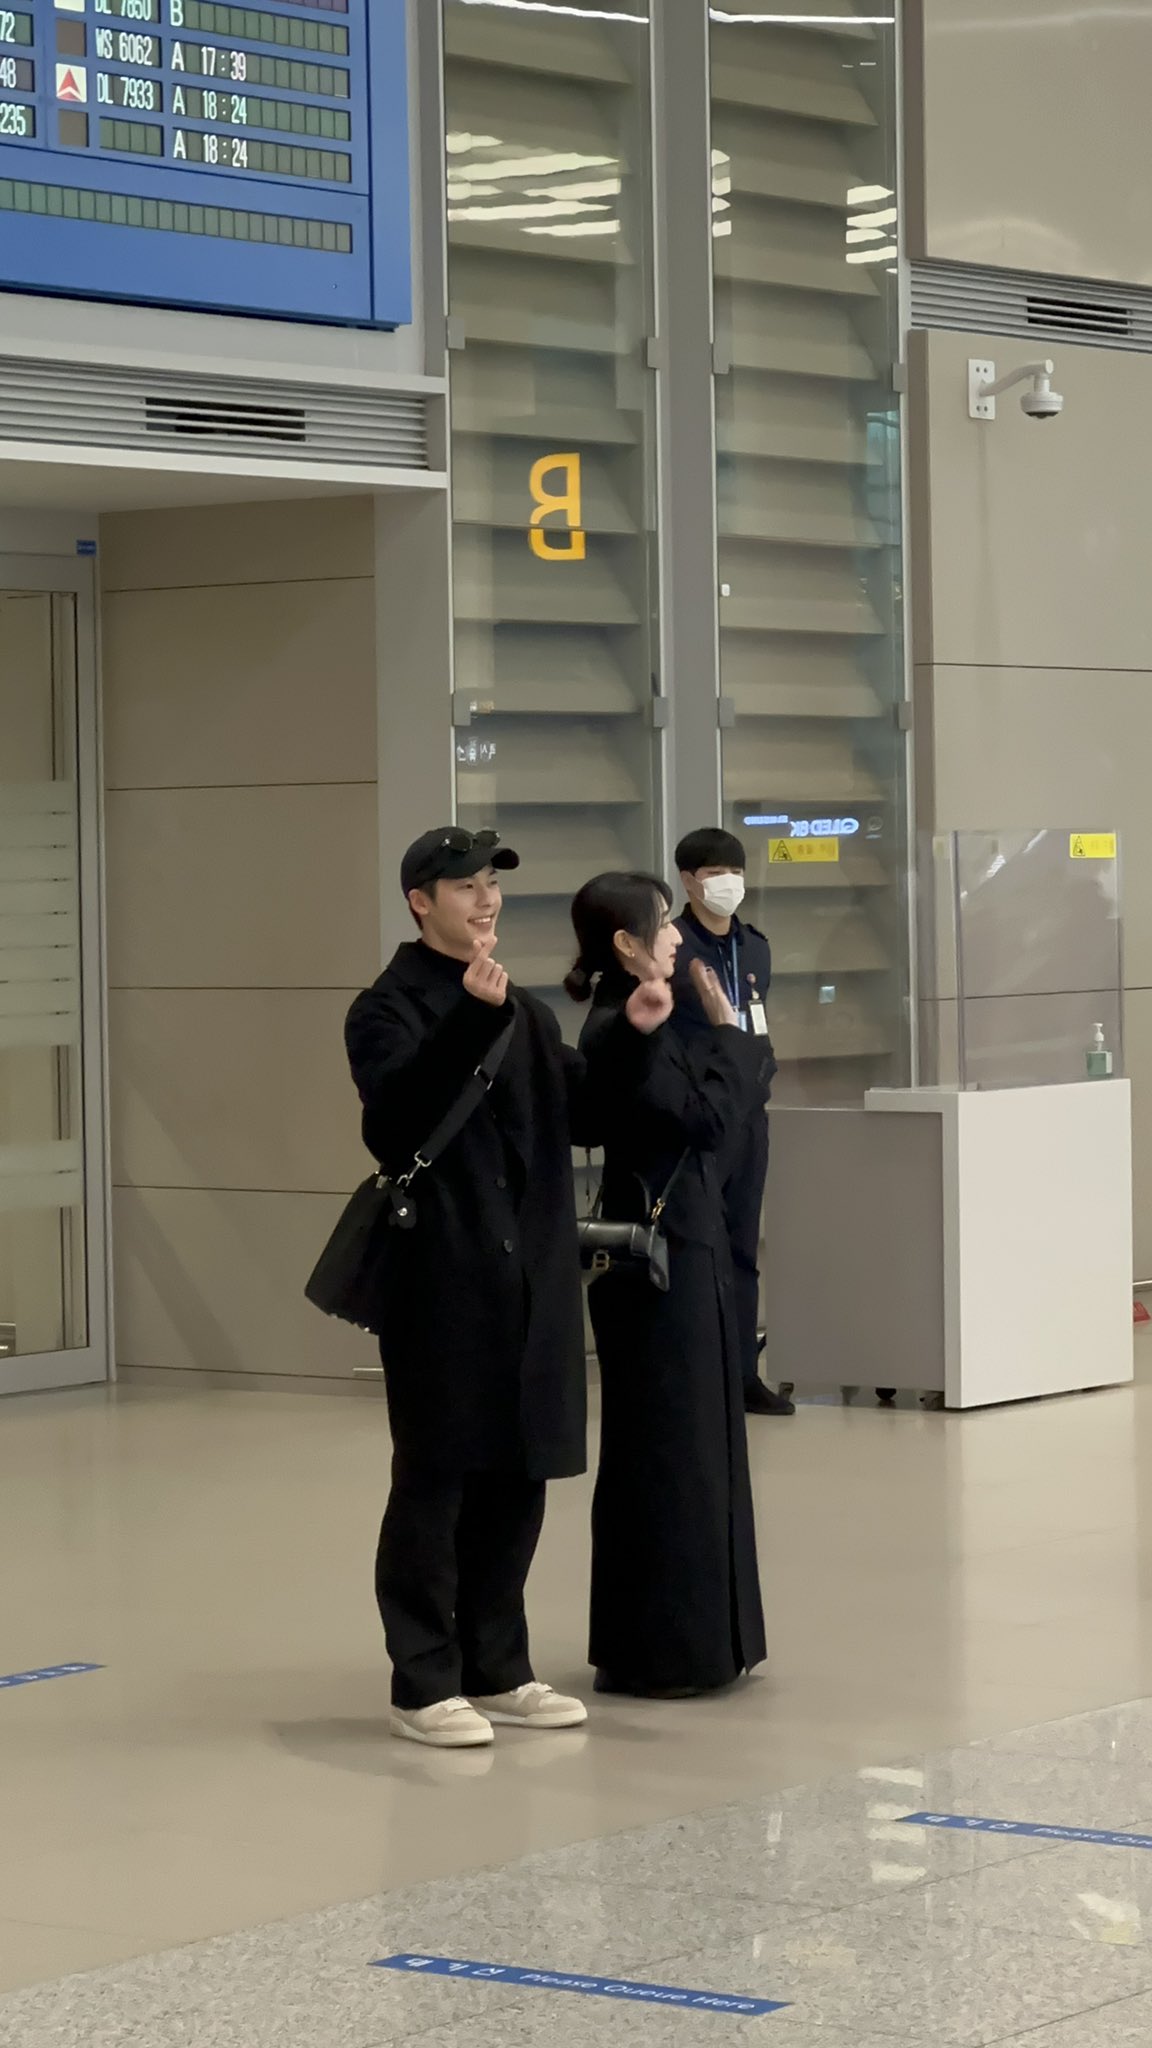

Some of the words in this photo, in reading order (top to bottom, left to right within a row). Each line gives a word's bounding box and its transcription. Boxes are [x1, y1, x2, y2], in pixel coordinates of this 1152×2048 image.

[0, 10, 15, 43] 72
[170, 0, 184, 26] B
[95, 28, 113, 59] WS
[119, 32, 152, 66] 6062
[171, 41, 185, 71] A
[0, 57, 16, 88] 48
[97, 73, 113, 104] DL
[120, 77, 154, 110] 7933
[172, 85, 186, 115] A
[0, 103, 26, 136] 235
[173, 129, 187, 160] A
[519, 1973, 598, 1988] Please
[603, 1984, 688, 2000] Queue
[692, 1996, 755, 2010] Here
